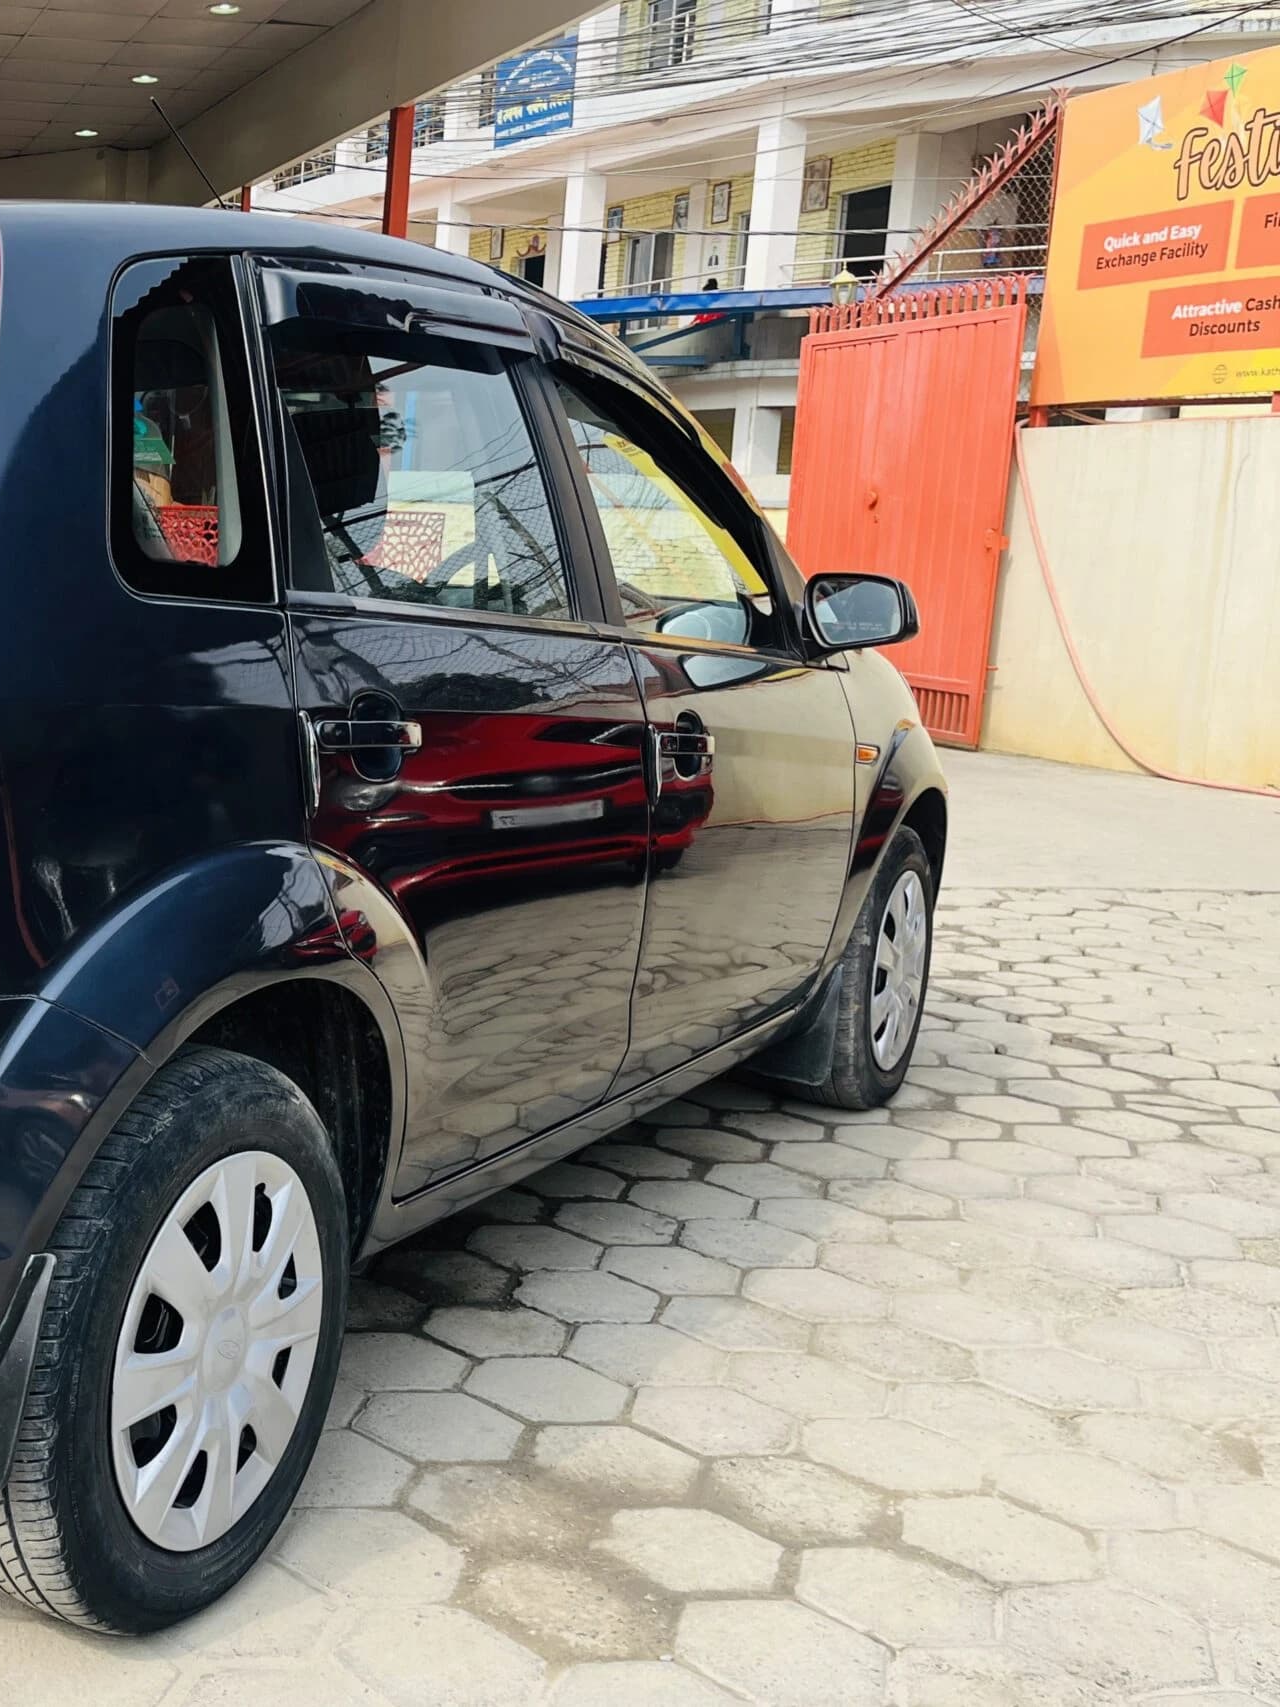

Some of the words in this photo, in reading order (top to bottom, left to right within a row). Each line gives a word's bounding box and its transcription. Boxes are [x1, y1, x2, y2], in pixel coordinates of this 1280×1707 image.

[1104, 232, 1141, 252] Quick
[1142, 227, 1169, 244] and
[1170, 224, 1202, 241] Easy
[1096, 251, 1157, 270] Exchange
[1159, 242, 1208, 261] Facility
[1171, 298, 1243, 320] Attractive
[1189, 319, 1261, 337] Discounts
